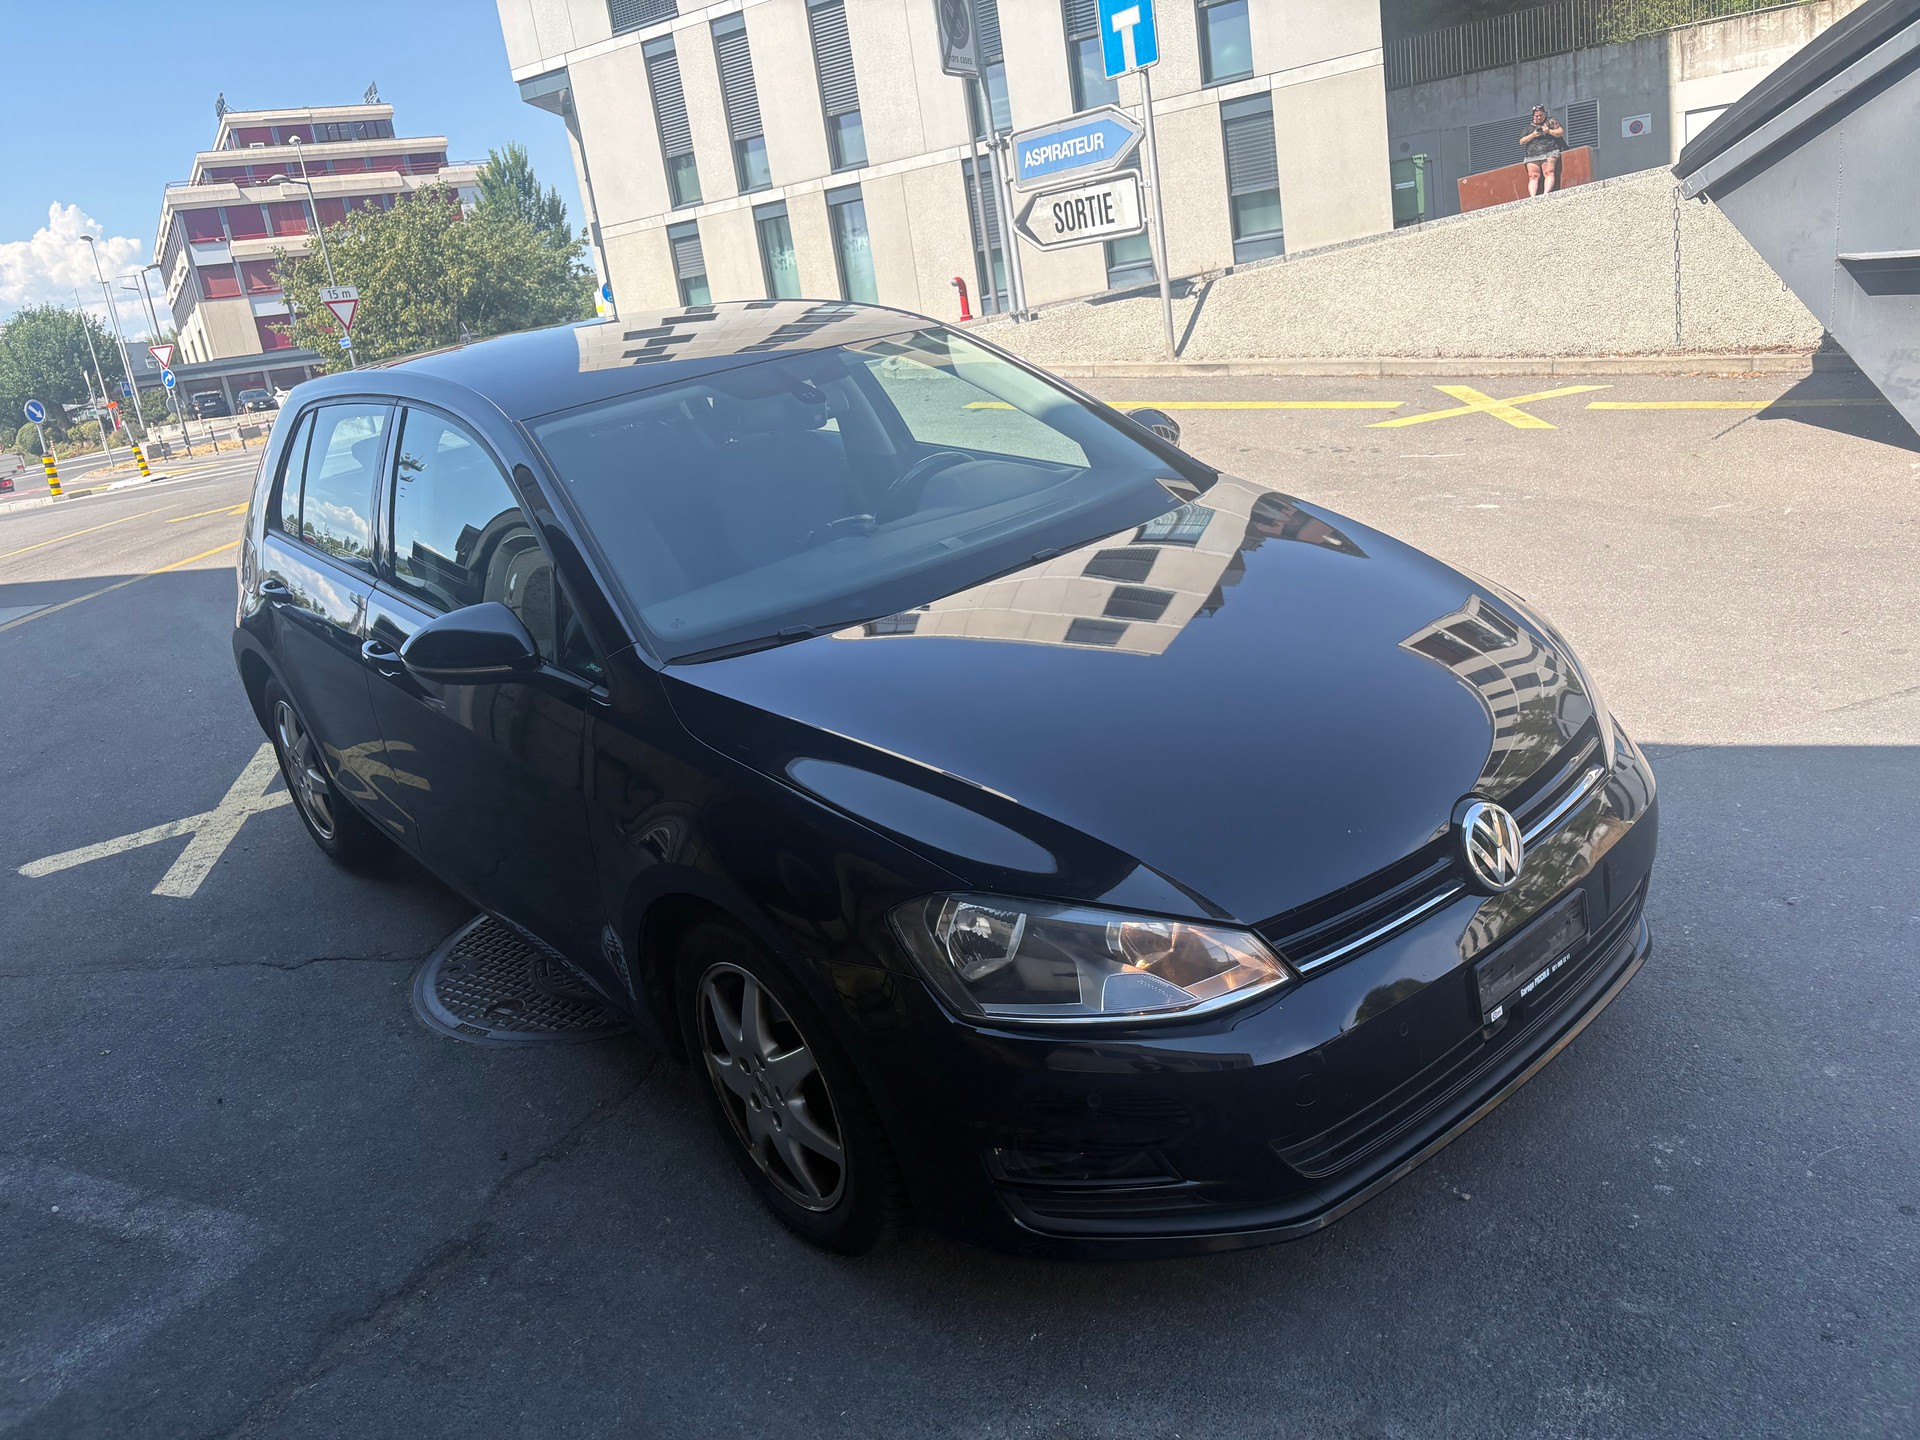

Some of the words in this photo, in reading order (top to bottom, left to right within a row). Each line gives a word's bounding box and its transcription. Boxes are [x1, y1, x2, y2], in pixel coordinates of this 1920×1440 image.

[1024, 132, 1104, 169] ASPIRATEUR
[1052, 192, 1116, 234] SORTIE
[327, 289, 339, 300] 15
[342, 290, 352, 299] m
